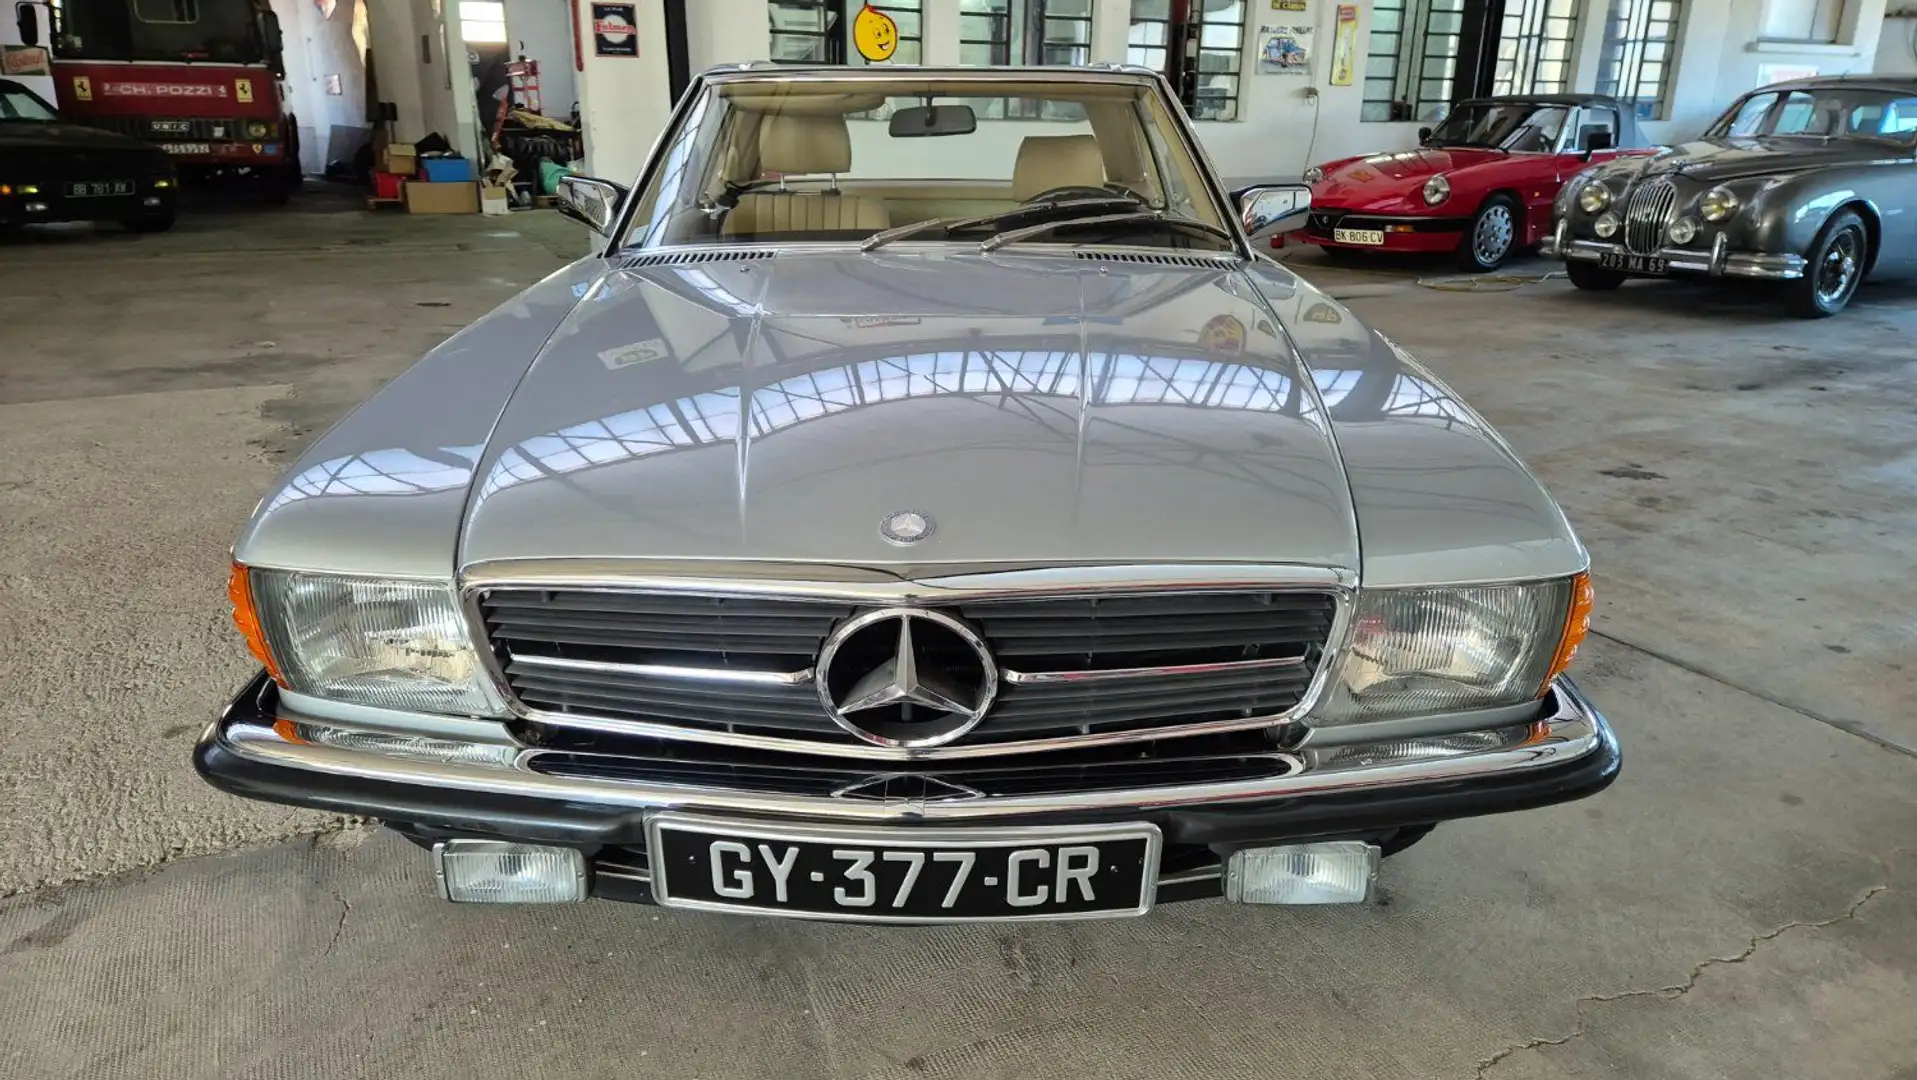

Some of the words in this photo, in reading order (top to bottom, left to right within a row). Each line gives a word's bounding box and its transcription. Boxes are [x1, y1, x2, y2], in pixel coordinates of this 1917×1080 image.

[156, 85, 213, 96] POZZI
[1335, 230, 1347, 240] BK
[1349, 231, 1368, 242] 806
[1369, 232, 1383, 242] CV
[1628, 256, 1644, 271] MA
[1648, 259, 1665, 273] 69
[708, 840, 1100, 908] GY-377-CR
